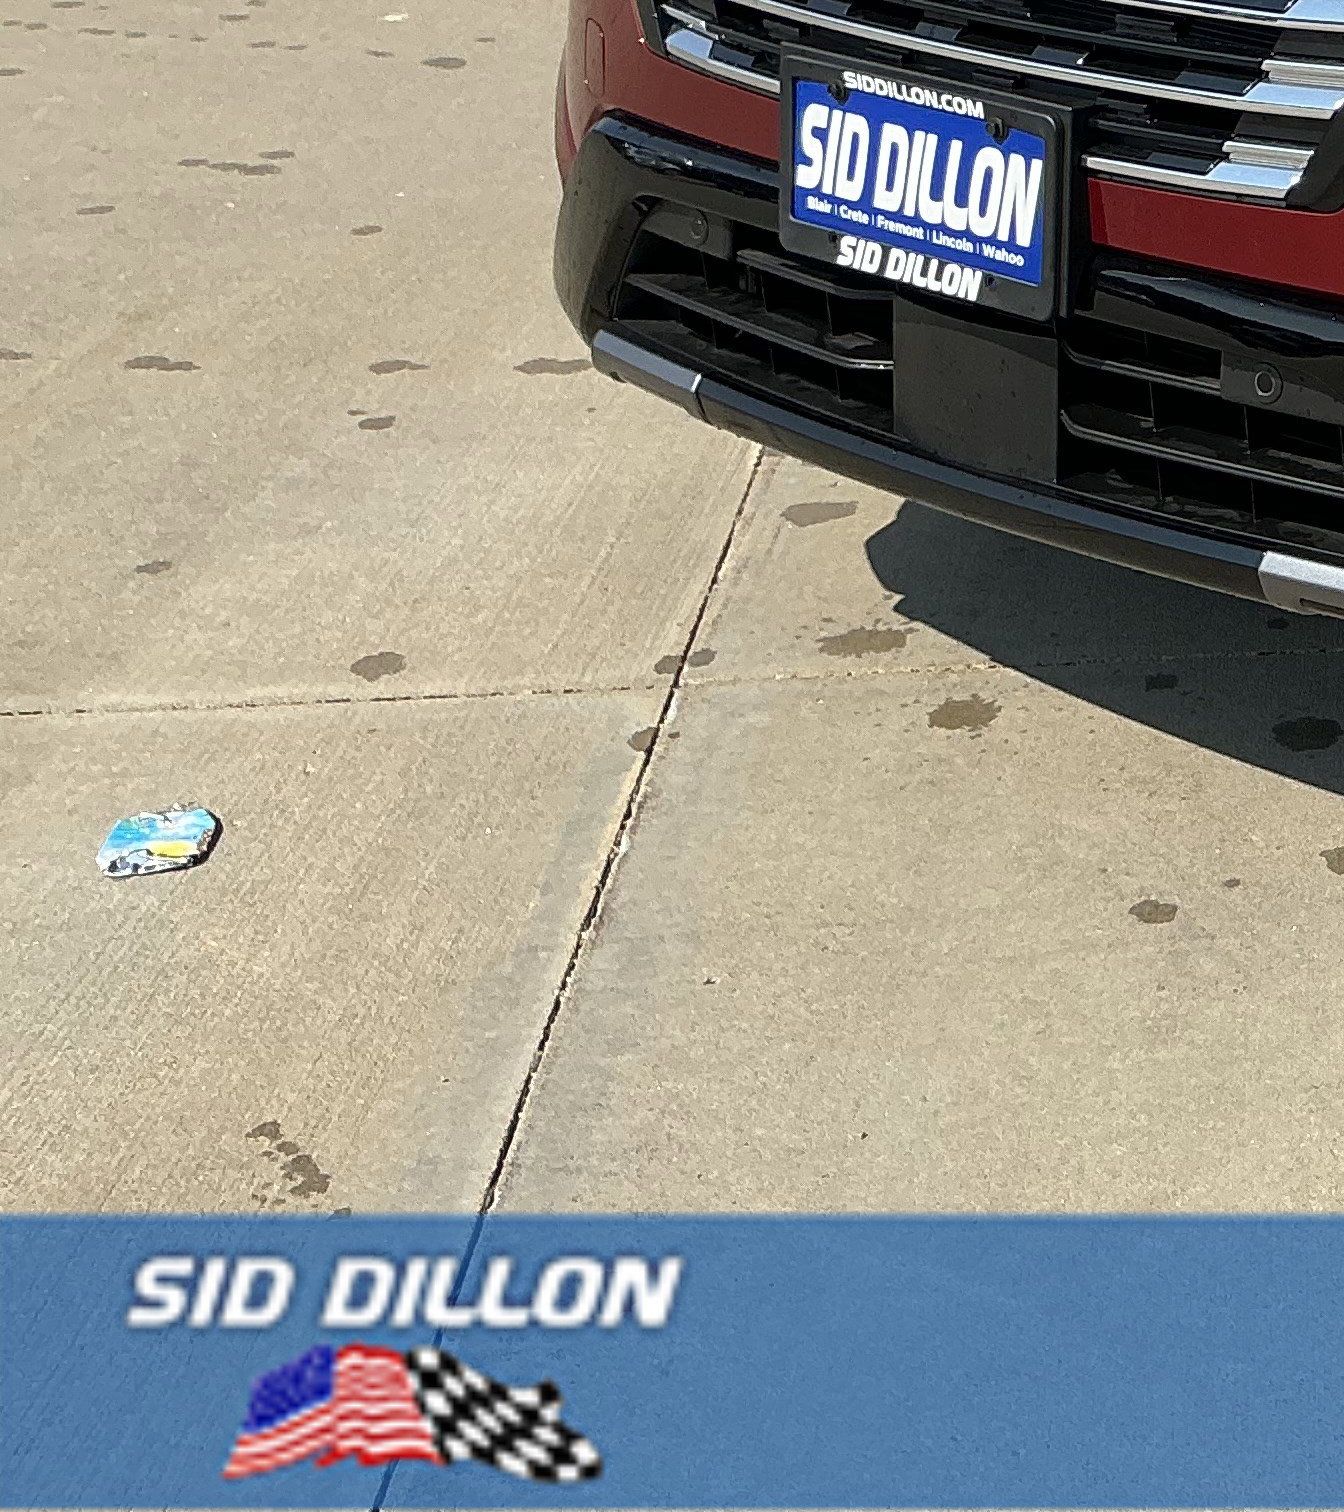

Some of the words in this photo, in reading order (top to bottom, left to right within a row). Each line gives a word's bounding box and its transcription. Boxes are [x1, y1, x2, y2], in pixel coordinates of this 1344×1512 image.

[842, 70, 985, 120] SIDDILLON.COM
[795, 103, 870, 203] SID
[873, 121, 1044, 248] DILLON
[807, 195, 833, 214] Blair
[839, 204, 869, 225] Crete
[877, 215, 924, 240] Fremont
[932, 230, 973, 254] Lincoln
[982, 243, 1025, 267] Wahoo
[836, 235, 882, 273] SID
[884, 247, 983, 302] DILLON
